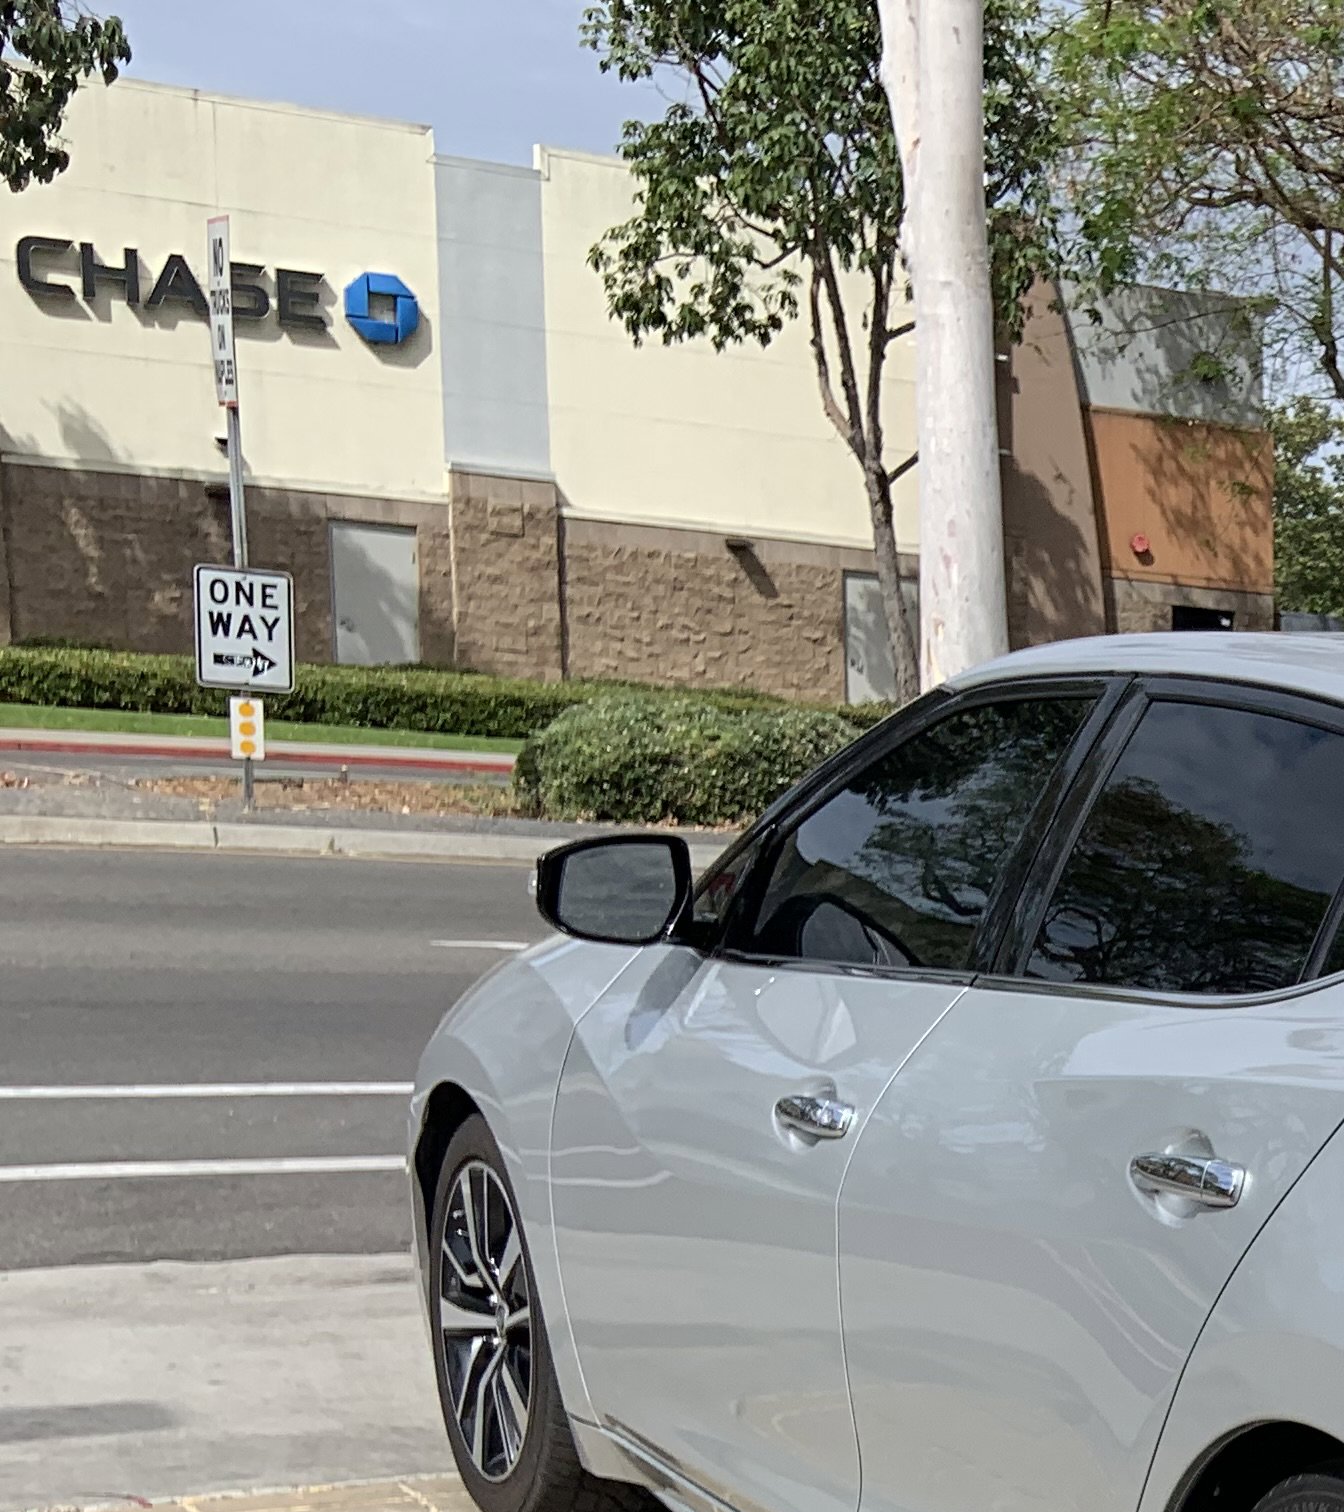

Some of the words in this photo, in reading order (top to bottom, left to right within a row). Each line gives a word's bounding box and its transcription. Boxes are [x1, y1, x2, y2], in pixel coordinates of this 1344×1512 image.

[17, 236, 326, 329] CHASE
[209, 578, 279, 610] ONE
[208, 610, 281, 642] WAY
